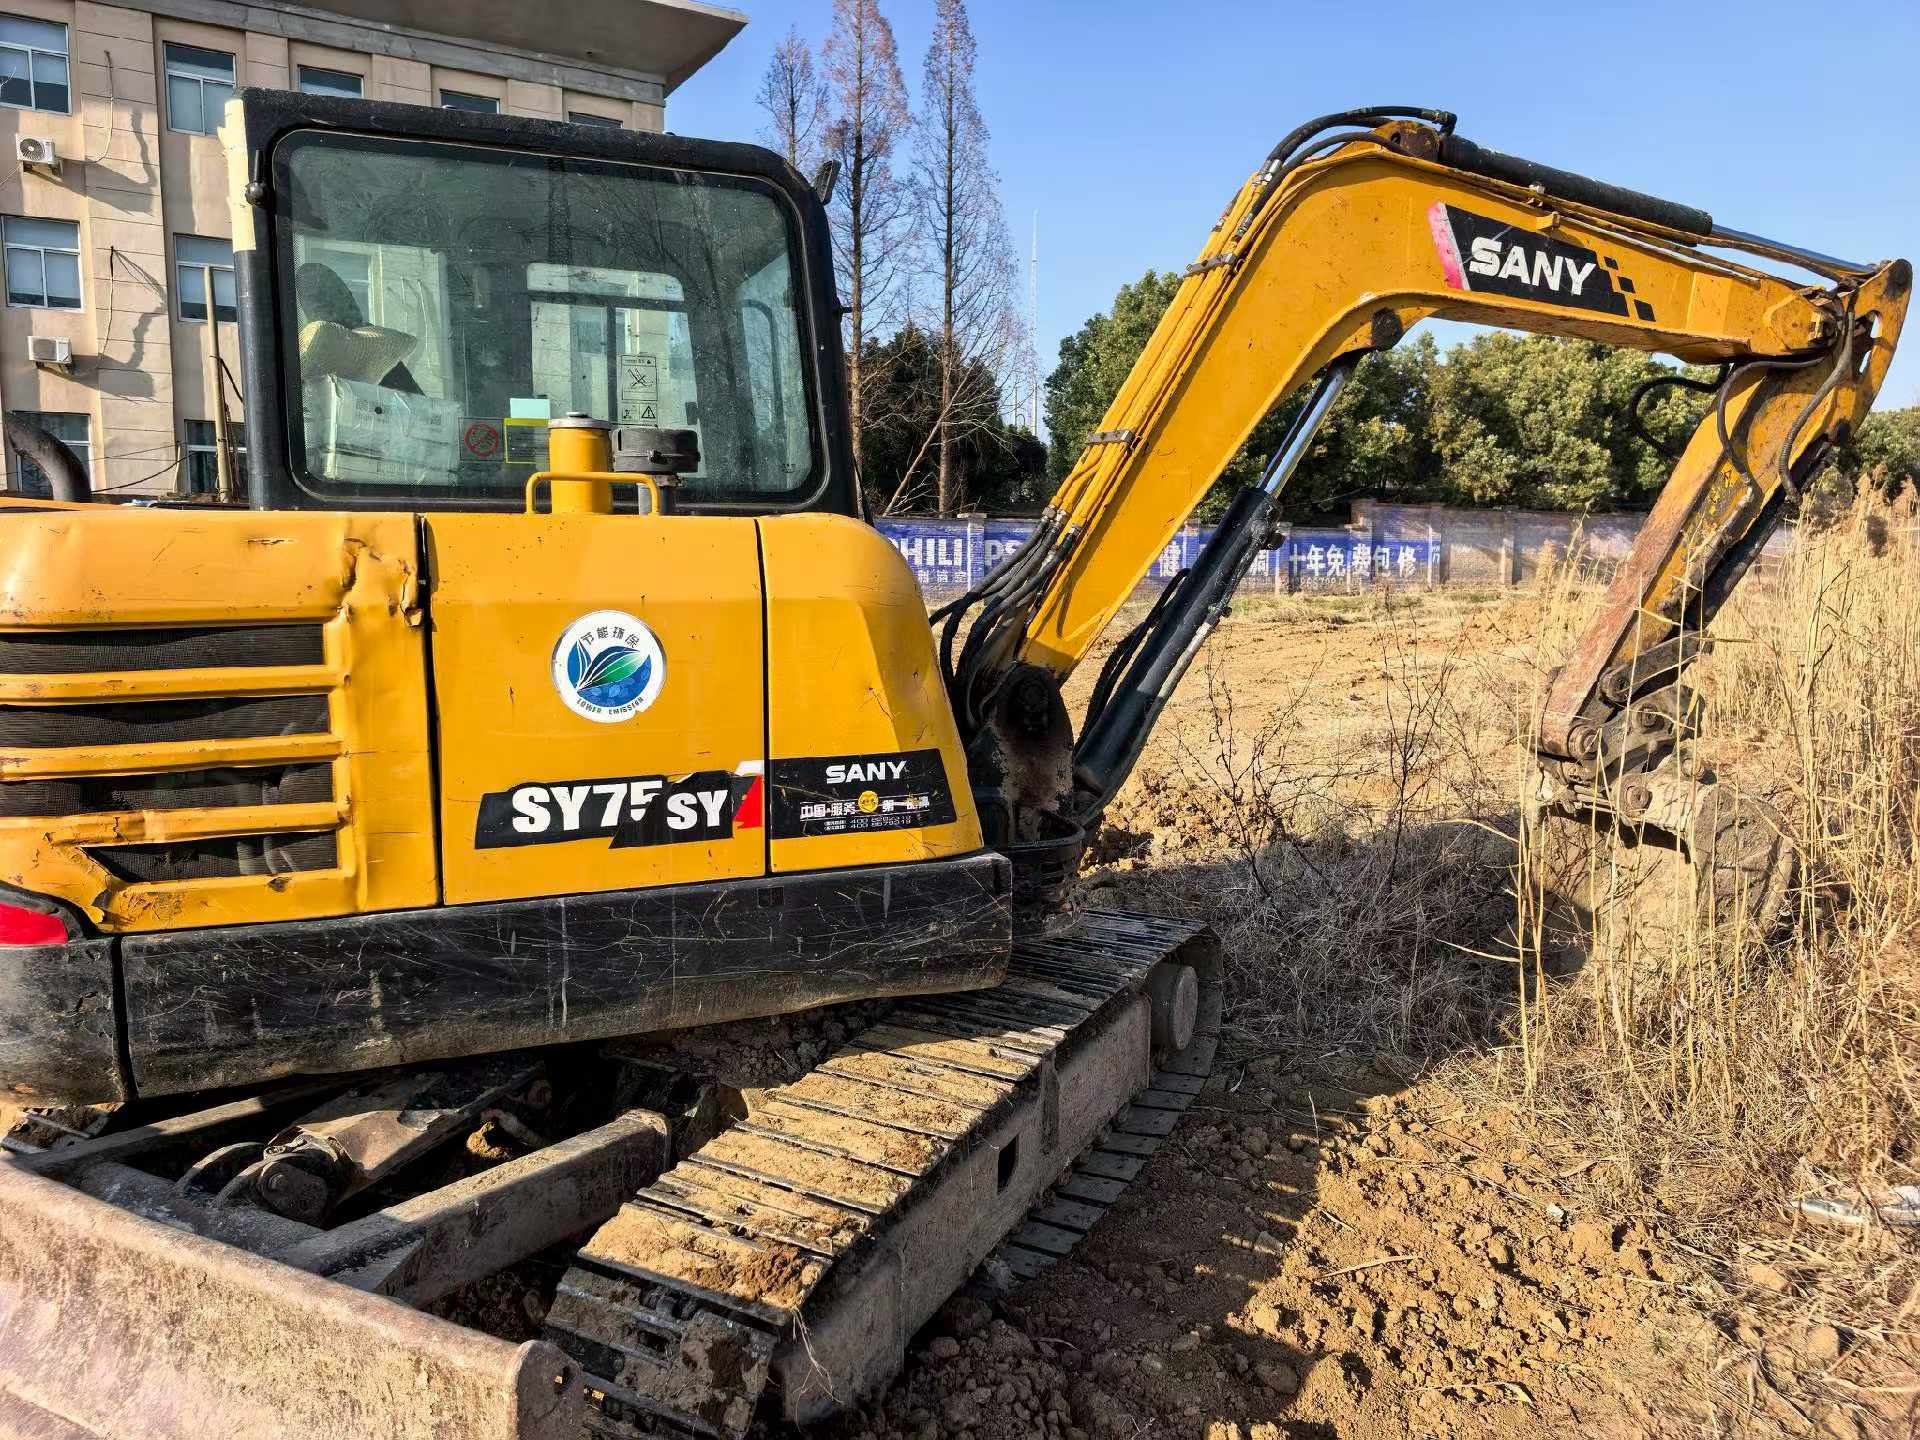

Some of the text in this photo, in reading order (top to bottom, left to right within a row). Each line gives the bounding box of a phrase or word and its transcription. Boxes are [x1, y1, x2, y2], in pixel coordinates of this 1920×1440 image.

[1468, 236, 1596, 296] SANY
[580, 626, 640, 649] 节能环保
[577, 696, 644, 715] LOWER EMISSION
[825, 760, 907, 784] SANY
[666, 789, 729, 830] SY
